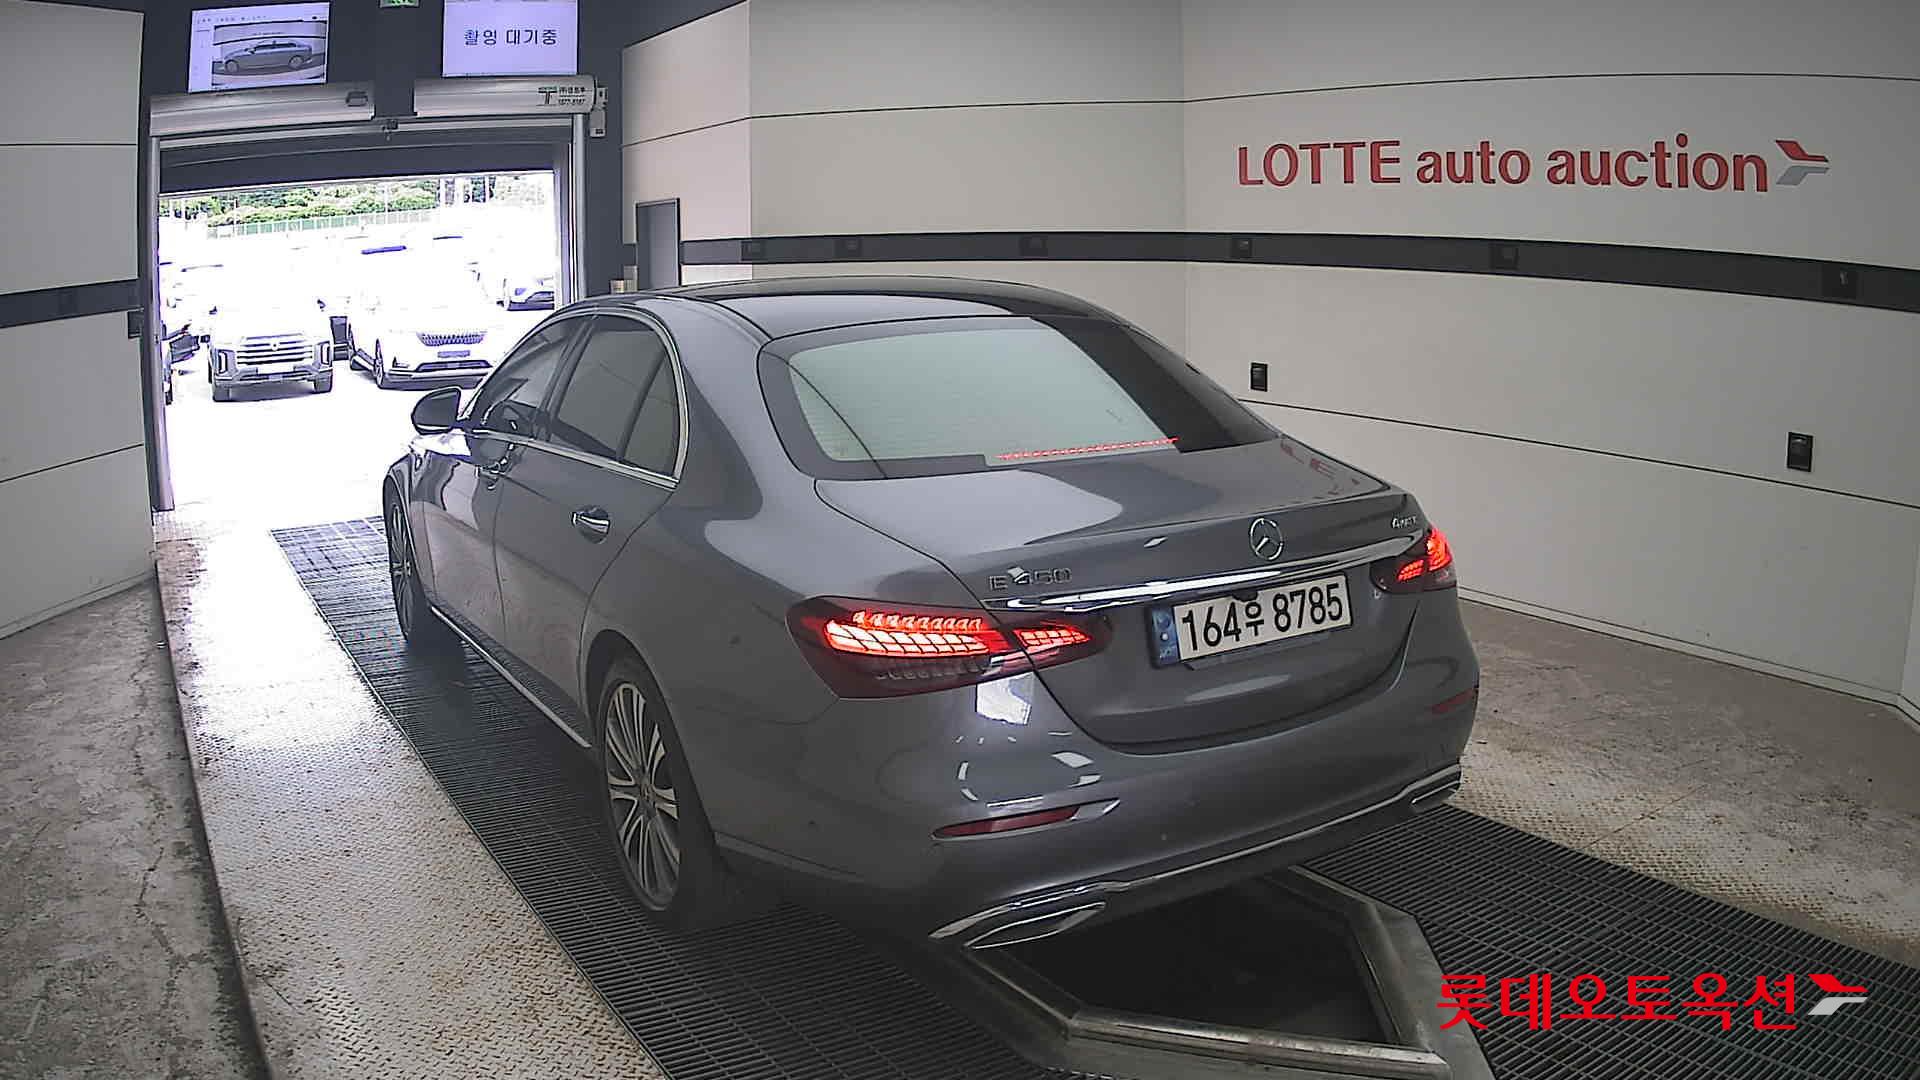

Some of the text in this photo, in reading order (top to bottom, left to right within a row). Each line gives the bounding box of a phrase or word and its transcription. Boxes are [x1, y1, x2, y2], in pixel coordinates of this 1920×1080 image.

[505, 29, 557, 46] 대기중
[1237, 133, 1769, 193] LOTTE auto auction
[1182, 582, 1343, 651] 164우 8785
